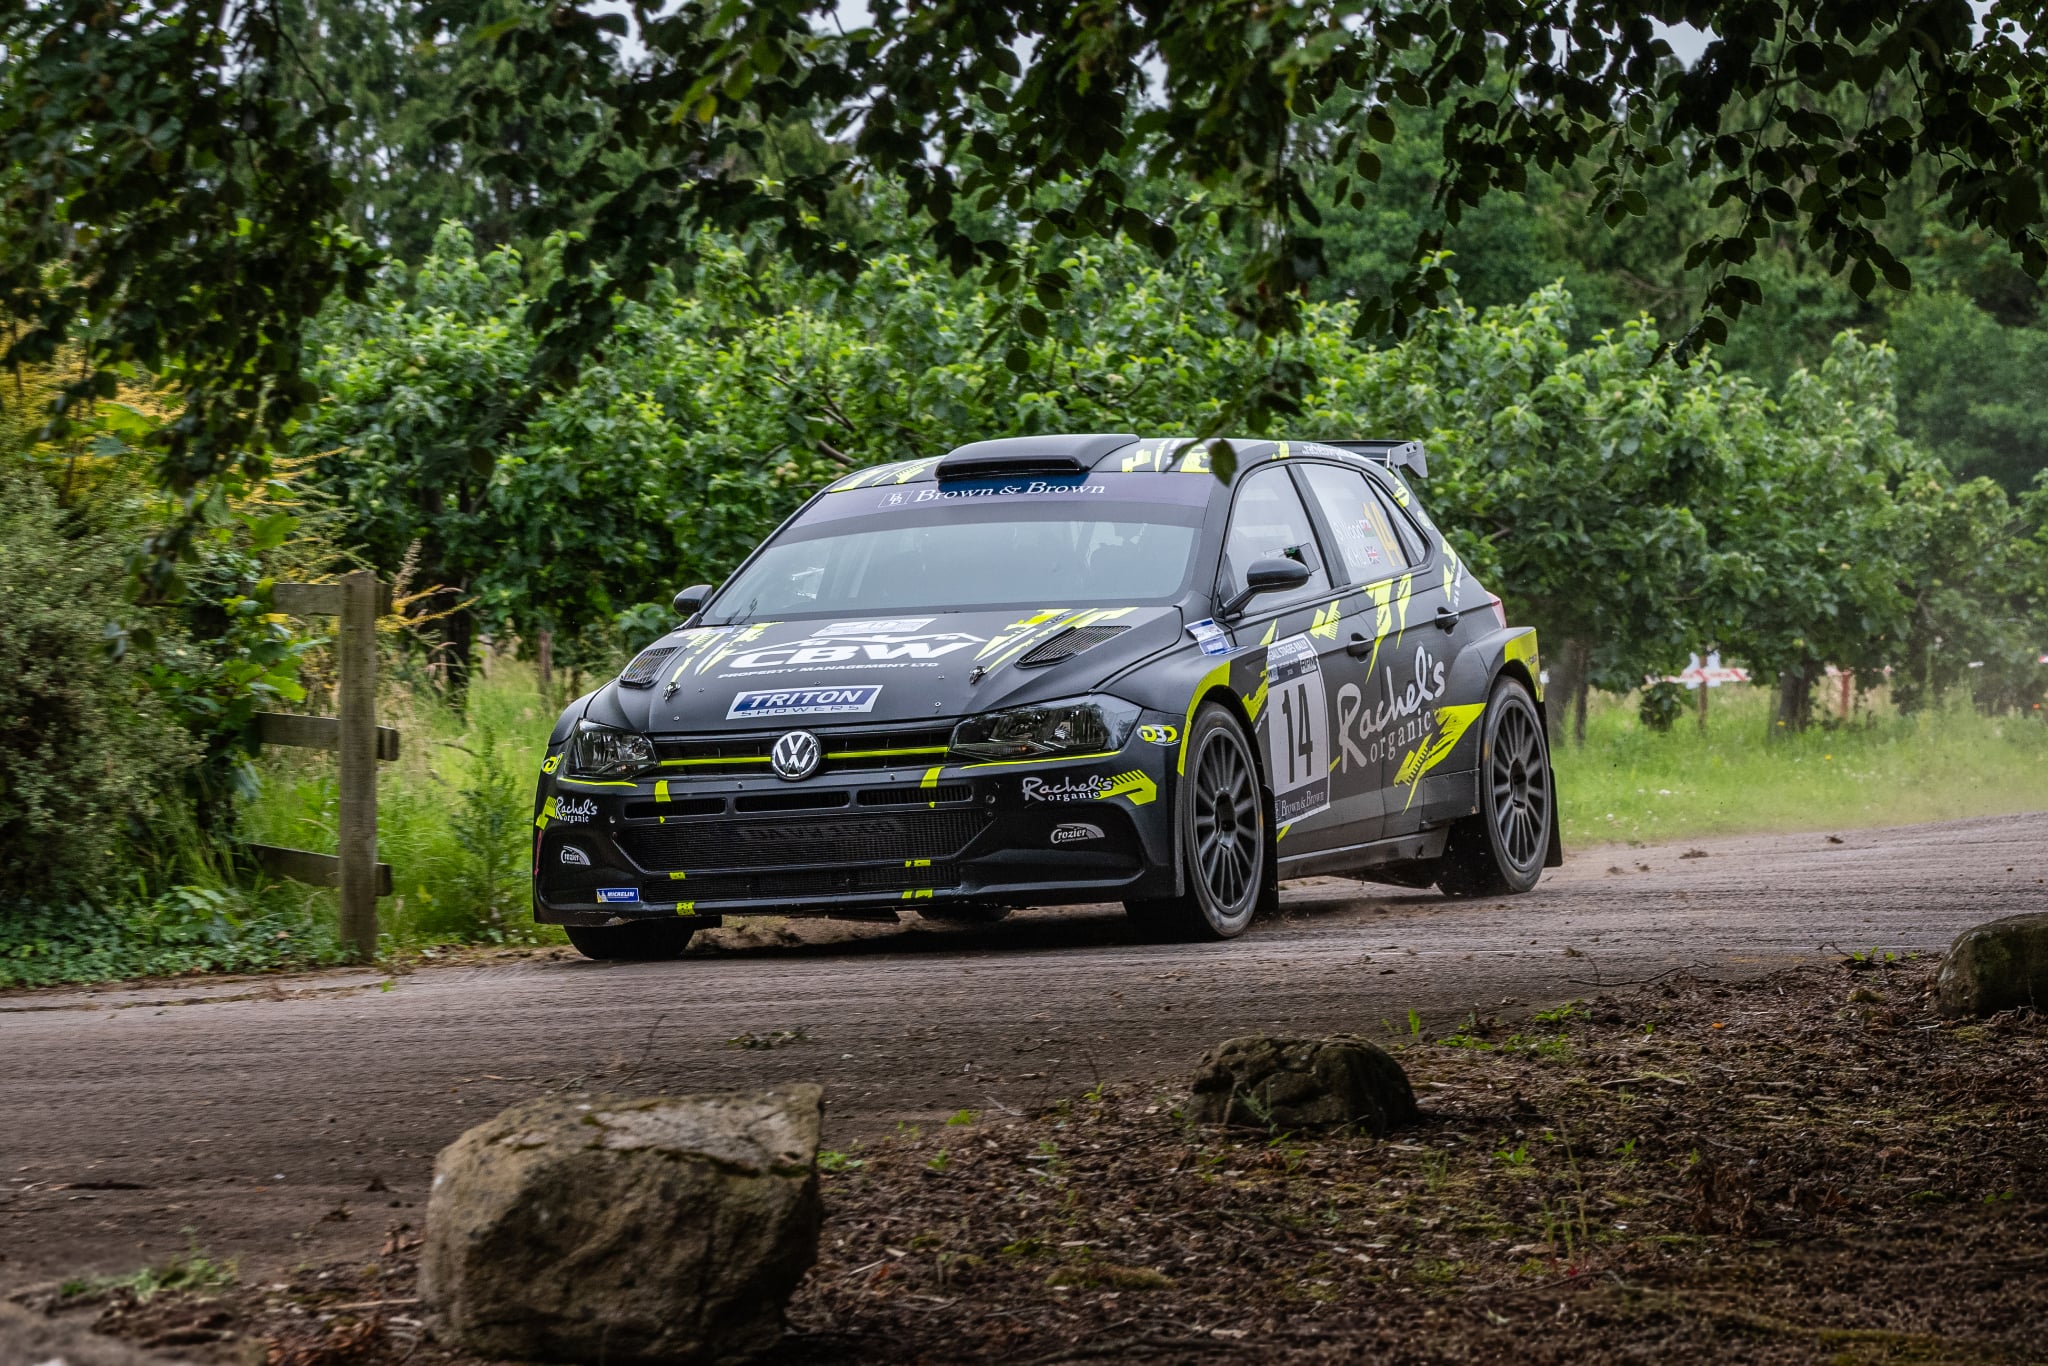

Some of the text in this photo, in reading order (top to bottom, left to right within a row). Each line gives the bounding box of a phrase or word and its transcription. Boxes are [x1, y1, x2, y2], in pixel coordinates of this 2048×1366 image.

[914, 481, 1105, 503] Brown & Brown
[1362, 501, 1405, 567] 14
[728, 642, 977, 669] CBW
[717, 667, 797, 679] PROPERTY
[799, 662, 904, 673] MANAGEMENT
[740, 705, 860, 717] SHOWERS
[750, 689, 863, 709] TRITON
[1337, 645, 1446, 774] Rachel's
[1282, 683, 1314, 784] 14
[1370, 708, 1432, 763] organic
[1022, 774, 1113, 801] Rachel's
[1047, 790, 1100, 802] organic
[555, 796, 598, 820] Rachel's
[1281, 800, 1301, 817] Brown
[1306, 790, 1325, 807] Brown
[563, 814, 589, 824] organic
[1051, 828, 1087, 844] Crozier
